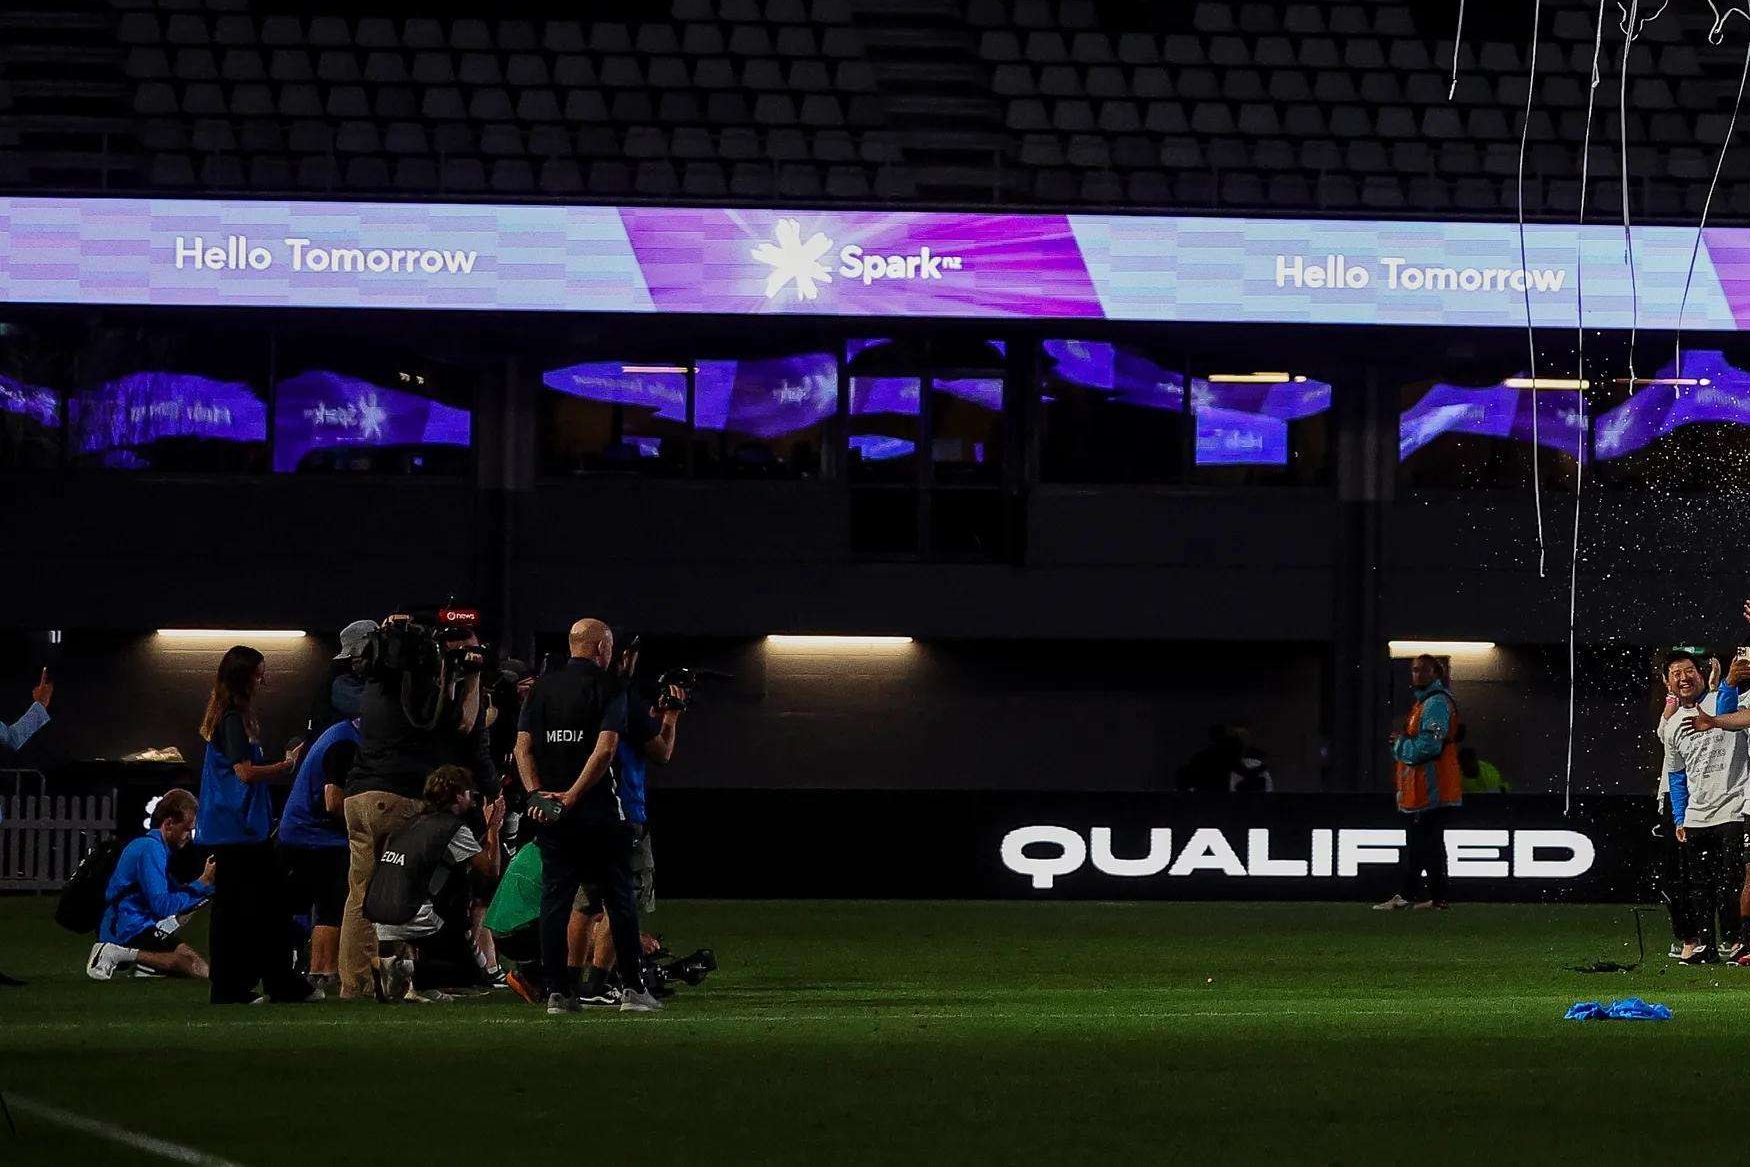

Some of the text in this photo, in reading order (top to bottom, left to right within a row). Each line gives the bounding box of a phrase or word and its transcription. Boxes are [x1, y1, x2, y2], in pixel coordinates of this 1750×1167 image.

[175, 235, 477, 273] Hello Tomorrow
[840, 244, 942, 285] Spark
[1276, 254, 1565, 291] Hello Tomorrow
[546, 730, 584, 743] MEDIA
[380, 850, 406, 866] EDIA
[1000, 825, 1596, 889] QUALIFED
